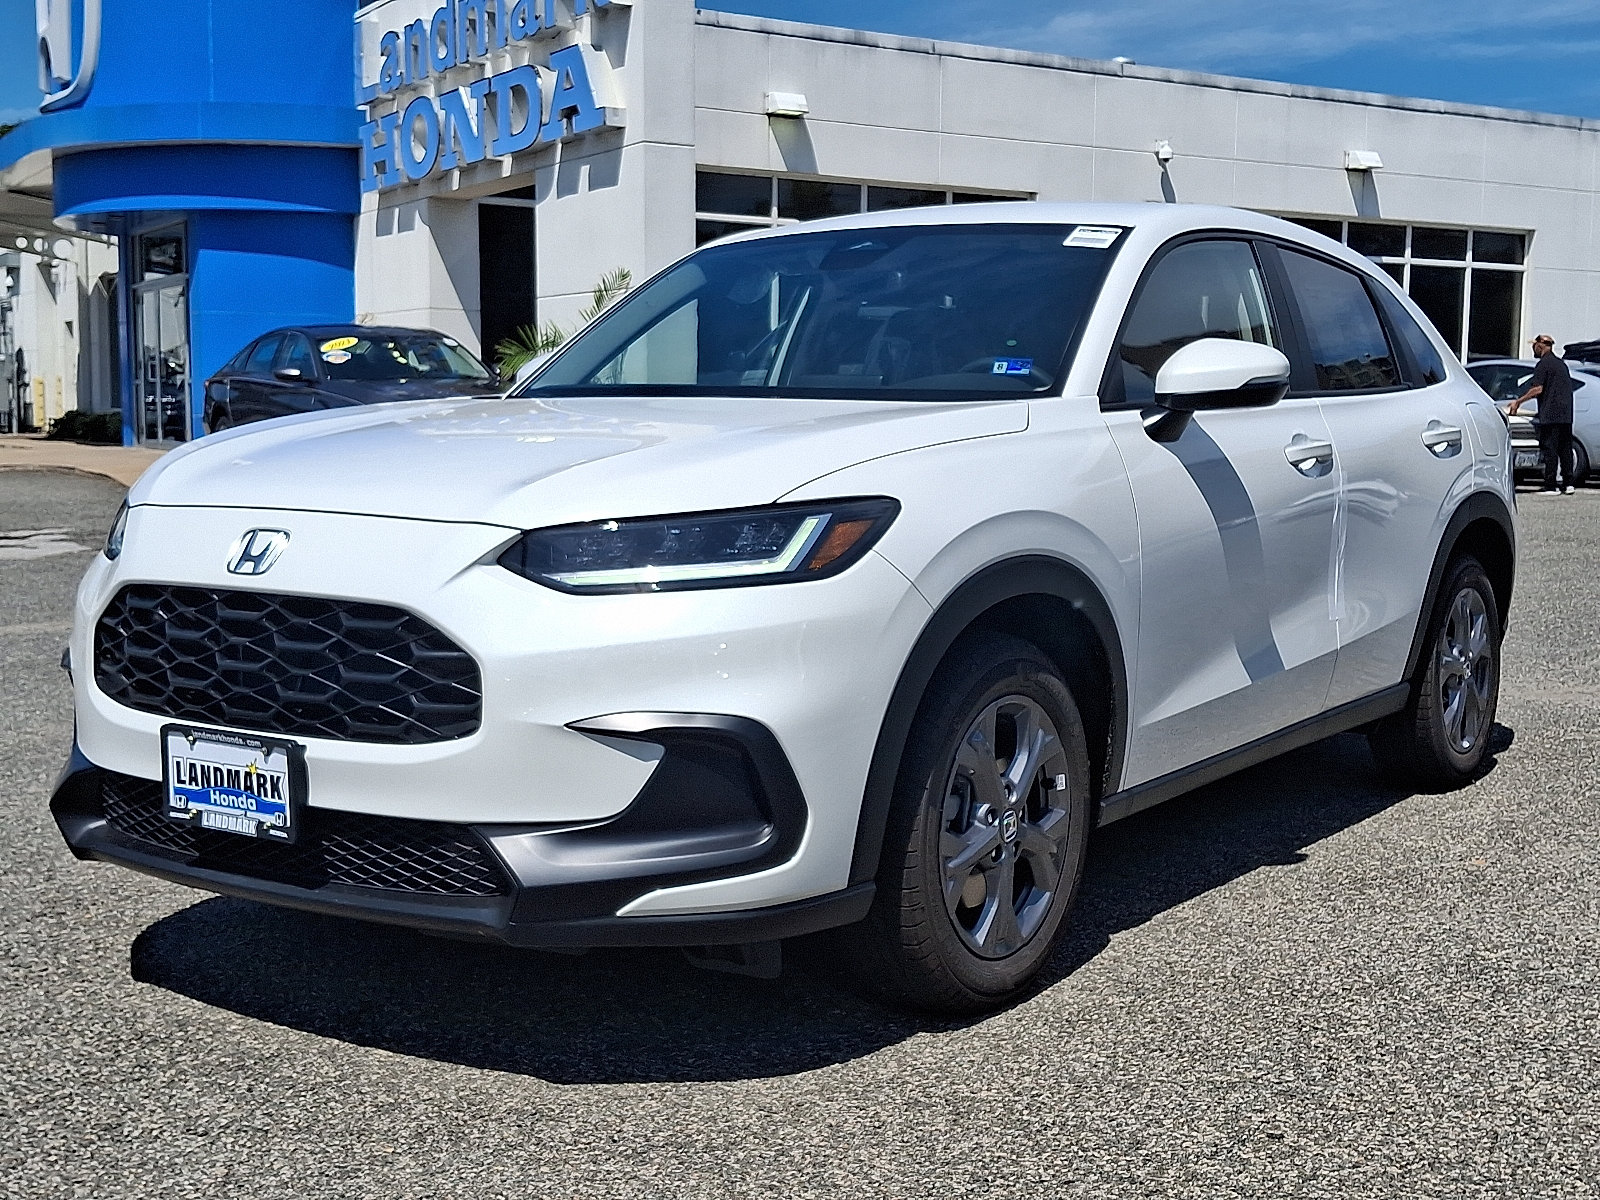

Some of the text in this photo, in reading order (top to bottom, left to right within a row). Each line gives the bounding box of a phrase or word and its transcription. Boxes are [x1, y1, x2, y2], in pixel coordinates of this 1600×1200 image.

[354, 0, 609, 105] Landma
[359, 44, 605, 193] HONDA
[175, 760, 283, 801] LANDMARK
[210, 789, 257, 811] Honda
[203, 811, 258, 835] LANDMARK
